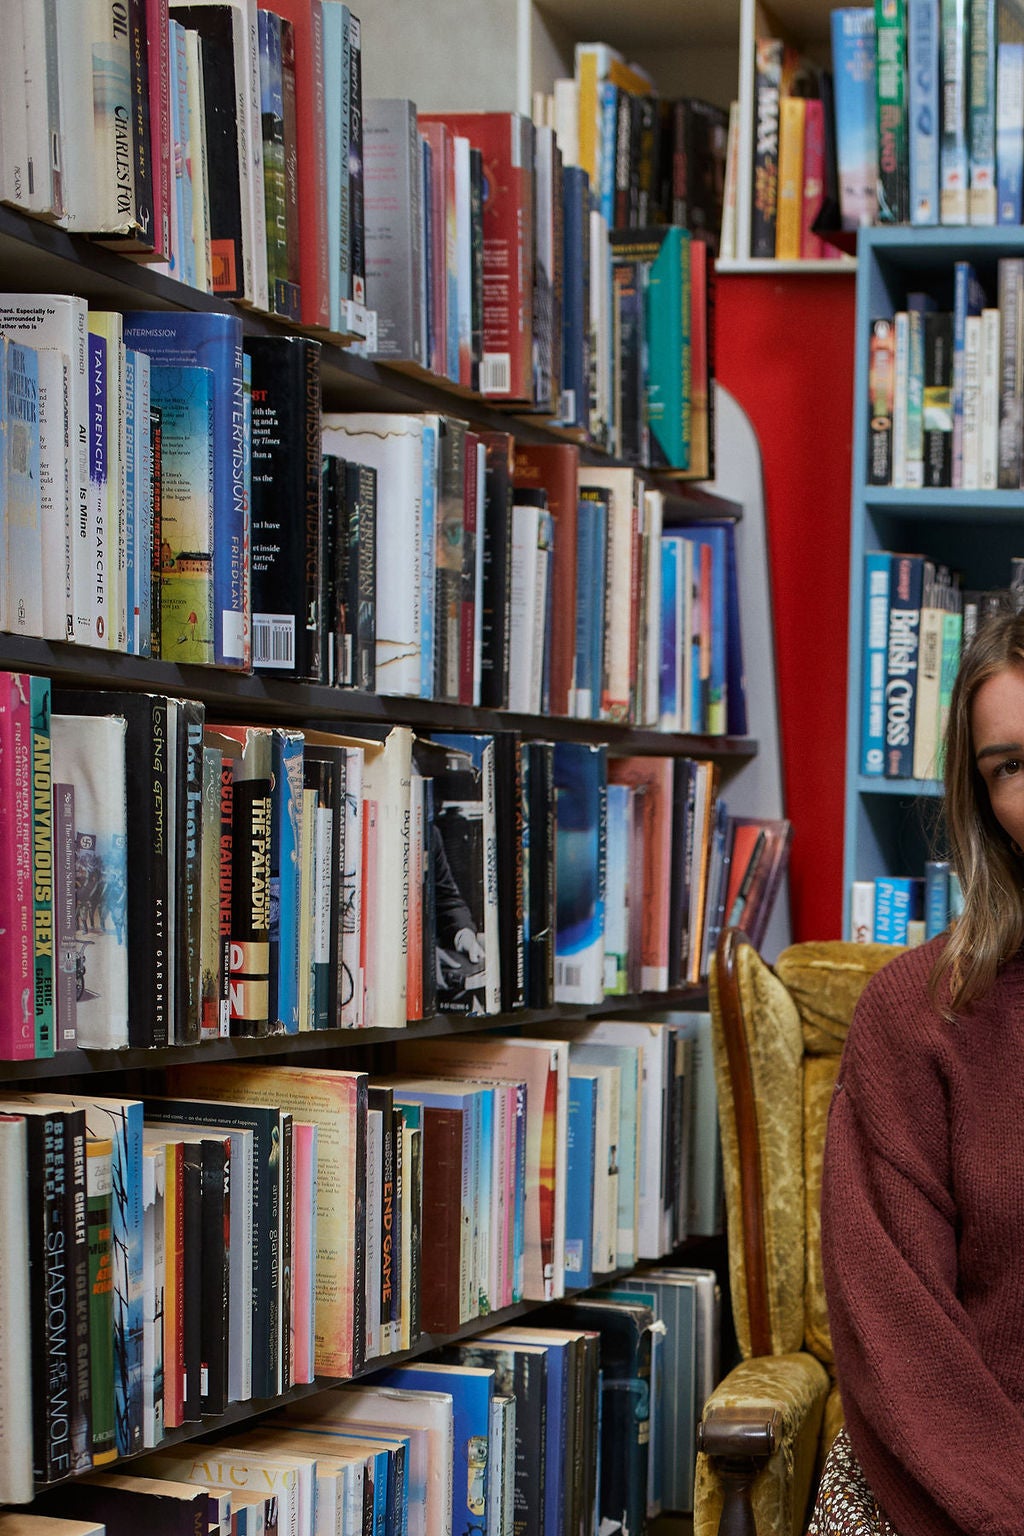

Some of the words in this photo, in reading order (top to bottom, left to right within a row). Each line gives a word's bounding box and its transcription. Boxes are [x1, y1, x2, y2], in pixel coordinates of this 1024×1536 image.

[113, 105, 131, 181] CHARLES
[273, 93, 287, 249] FAITHFUL
[117, 184, 132, 216] FOX
[340, 248, 348, 273] FOX
[16, 308, 45, 316] Especially
[76, 313, 84, 336] Ray
[124, 328, 177, 337] INTERMISSION
[77, 337, 86, 376] French
[94, 348, 103, 396] TANA
[126, 363, 134, 419] ESTHER
[265, 408, 276, 416] the
[79, 424, 87, 443] All
[95, 403, 105, 473] FRENCH
[260, 417, 273, 426] and
[306, 348, 320, 485] INADMISSIBLE
[233, 377, 245, 513] INTERMISSION
[262, 437, 280, 446] Times
[79, 487, 88, 501] Is
[262, 474, 273, 483] the
[79, 503, 88, 539] Mine
[306, 491, 320, 582] EVIDENCE
[413, 497, 421, 552] THREADS
[260, 544, 281, 553] inside
[365, 520, 374, 596] FRIEDMAN
[887, 608, 919, 675] British
[886, 678, 913, 746] Cross
[187, 723, 203, 782] Don
[15, 791, 24, 839] SCHOOL
[33, 733, 51, 901] ANONYMOUS
[219, 770, 232, 824] SCOT
[252, 798, 266, 836] THE
[65, 823, 73, 837] The
[186, 789, 202, 860] Juan
[400, 809, 412, 839] Buy
[65, 838, 73, 870] Sudbury
[401, 843, 411, 878] Back
[219, 835, 234, 936] GARDNER
[251, 840, 266, 930] PALADIN
[34, 909, 52, 957] REX
[65, 898, 73, 929] Murders
[35, 967, 44, 1016] GARCIA
[516, 946, 524, 989] GARRISON
[43, 978, 52, 1006] ERIC
[368, 1127, 374, 1135] A
[45, 1120, 55, 1201] GHELFI
[54, 1120, 64, 1195] BRENT
[73, 1136, 84, 1186] BRENT
[383, 1182, 392, 1230] END
[396, 1175, 402, 1199] ON
[75, 1191, 86, 1245] GHELFI
[269, 1229, 278, 1289] giardini
[383, 1234, 392, 1304] GAME
[47, 1230, 68, 1356] SHADOW
[49, 1362, 59, 1389] THE
[58, 1362, 68, 1379] OF
[77, 1344, 89, 1401] GAME
[49, 1388, 70, 1471] WOLF
[289, 1482, 297, 1511] Never
